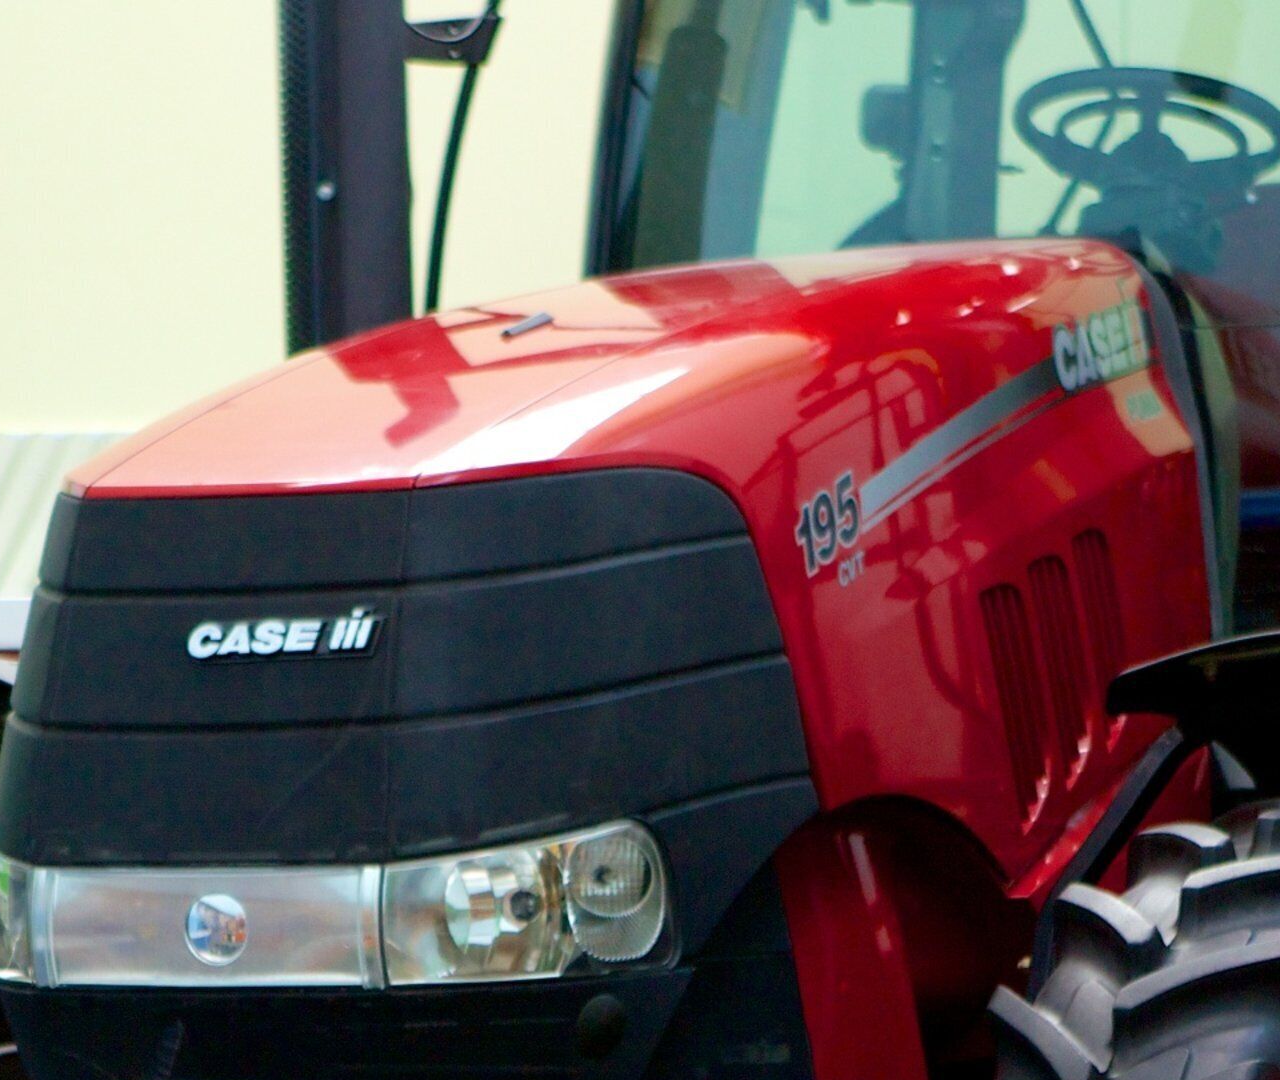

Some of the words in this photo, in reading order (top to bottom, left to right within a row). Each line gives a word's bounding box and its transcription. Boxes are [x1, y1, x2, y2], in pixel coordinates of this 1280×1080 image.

[794, 469, 859, 579] 195
[838, 550, 865, 587] CVT
[187, 620, 322, 659] CASE
